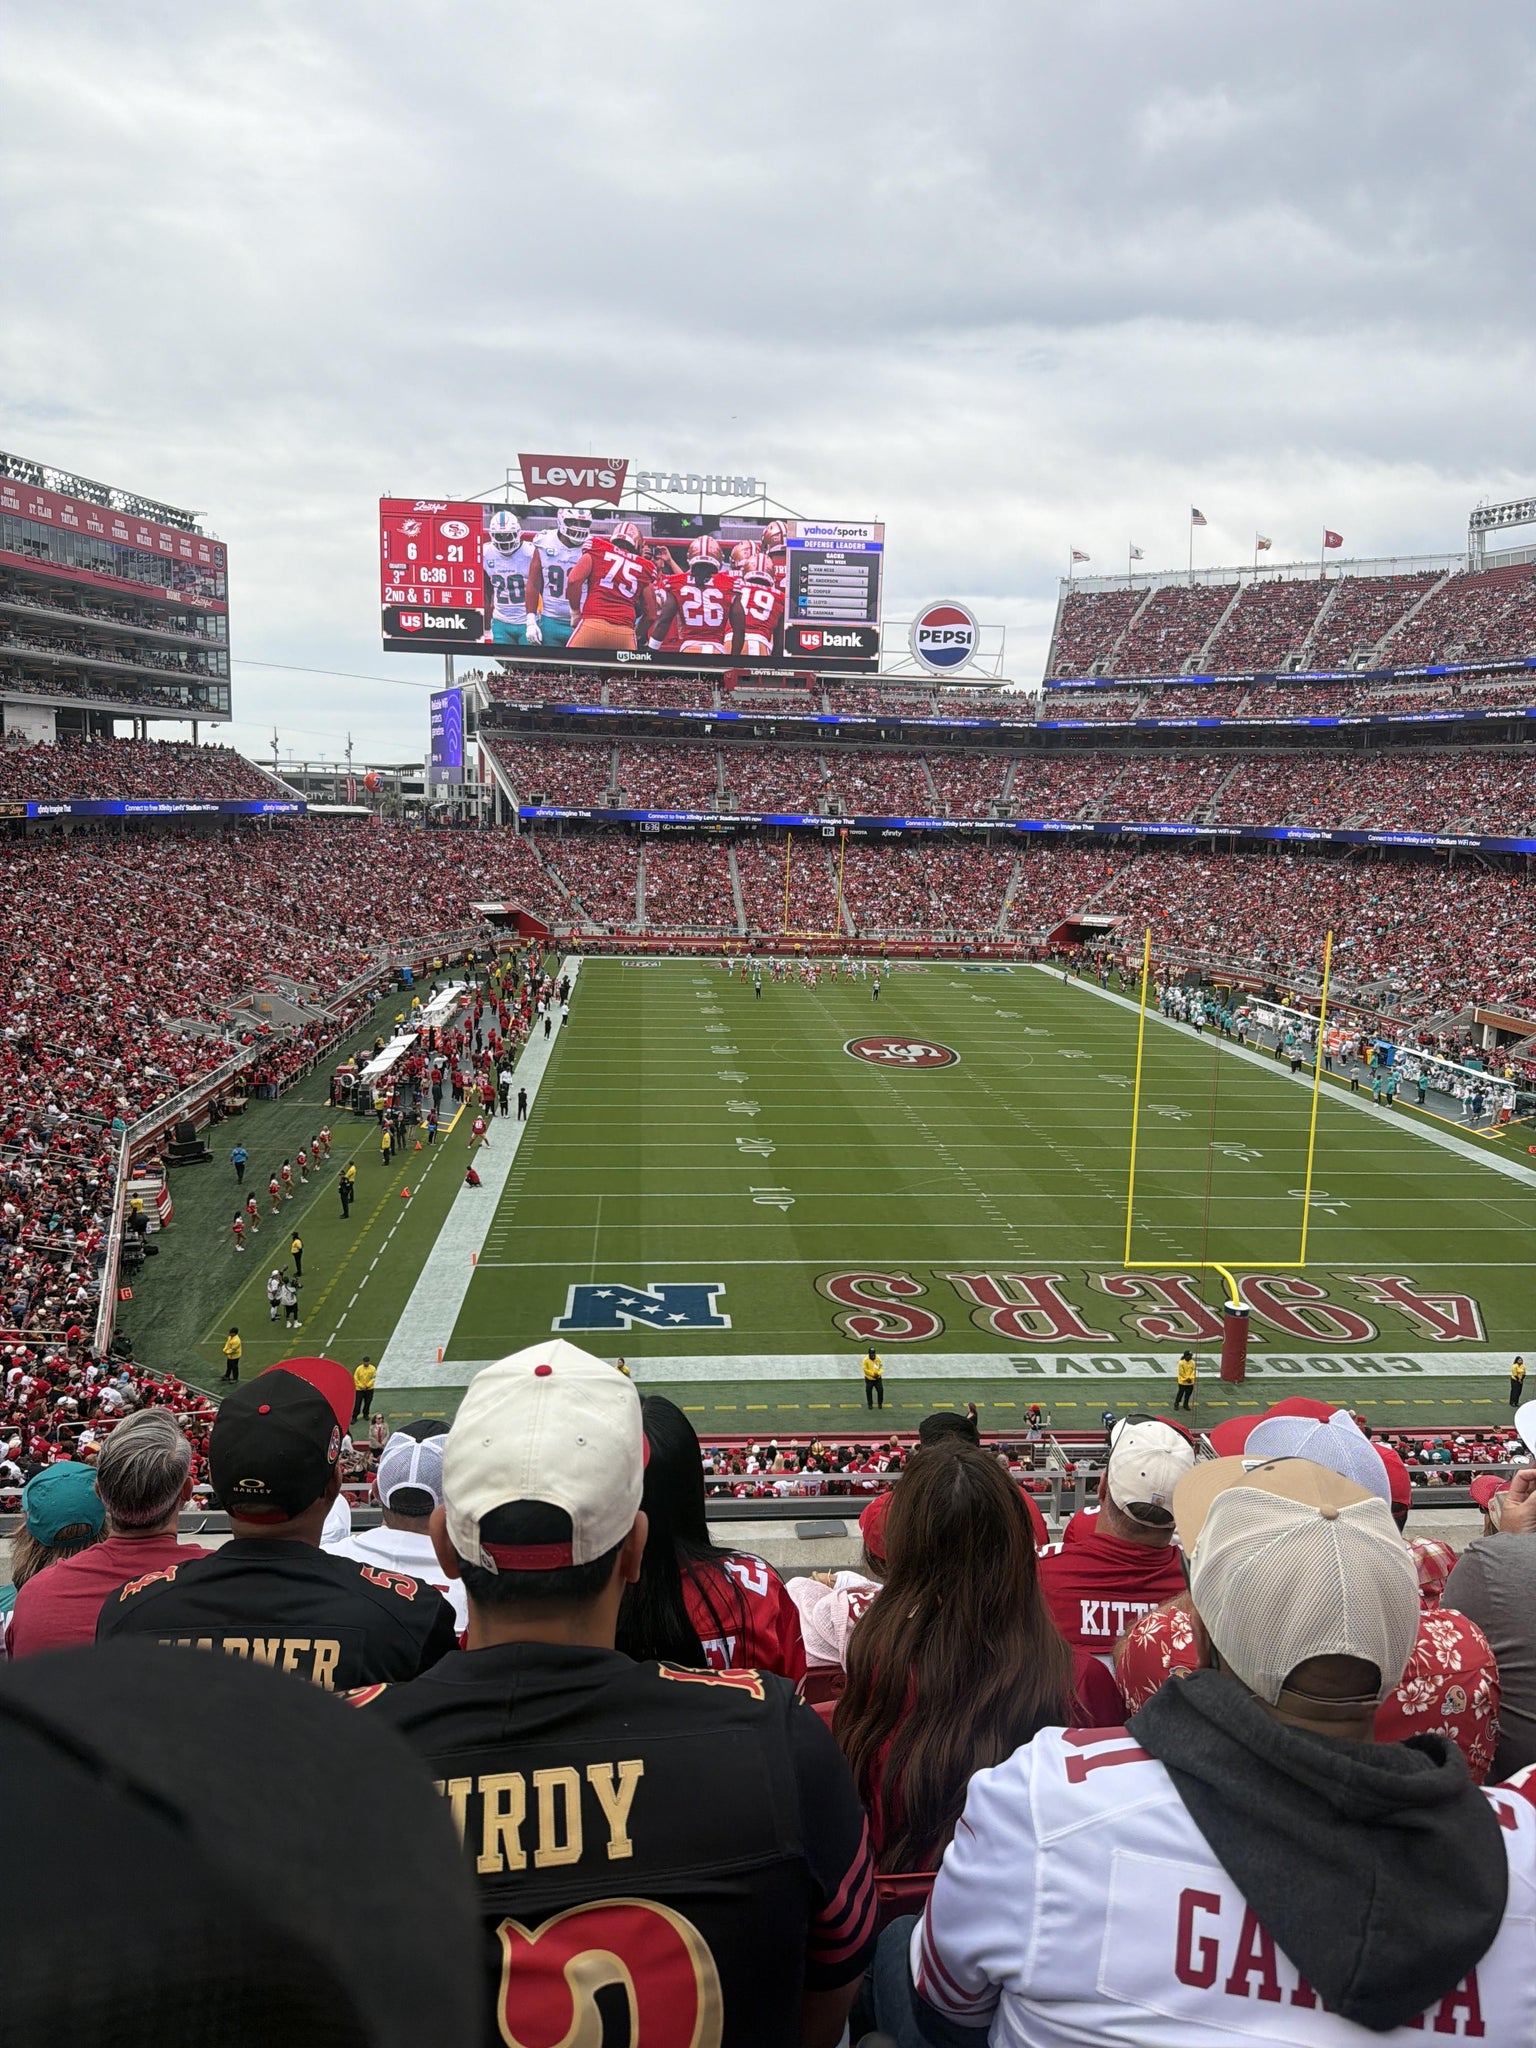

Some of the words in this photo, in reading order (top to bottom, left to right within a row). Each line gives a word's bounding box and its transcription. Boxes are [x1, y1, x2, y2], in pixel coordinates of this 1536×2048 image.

[636, 471, 756, 497] STADIUM
[413, 500, 447, 514] Faithful
[407, 542, 417, 560] 6
[447, 544, 464, 563] 21
[836, 542, 866, 550] LEADERS
[420, 567, 447, 583] 6:36
[462, 569, 475, 583] 13
[599, 551, 643, 599] 75
[385, 587, 405, 602] 2ND
[407, 588, 417, 603] &
[423, 589, 431, 604] 5
[465, 591, 473, 604] 8
[680, 585, 724, 627] 26
[740, 587, 775, 621] 19
[401, 615, 420, 627] us
[424, 613, 466, 629] bank
[801, 634, 820, 646] us
[823, 631, 862, 647] bank
[919, 630, 972, 644] PEPSI
[629, 651, 652, 661] bank
[882, 829, 903, 837] xfinity
[813, 1268, 1489, 1344] 49ERS
[1008, 1357, 1168, 1374] LOVE
[233, 1486, 272, 1495] OAKLEY
[1080, 1599, 1158, 1637] KITT
[1174, 1887, 1486, 2038] GAA
